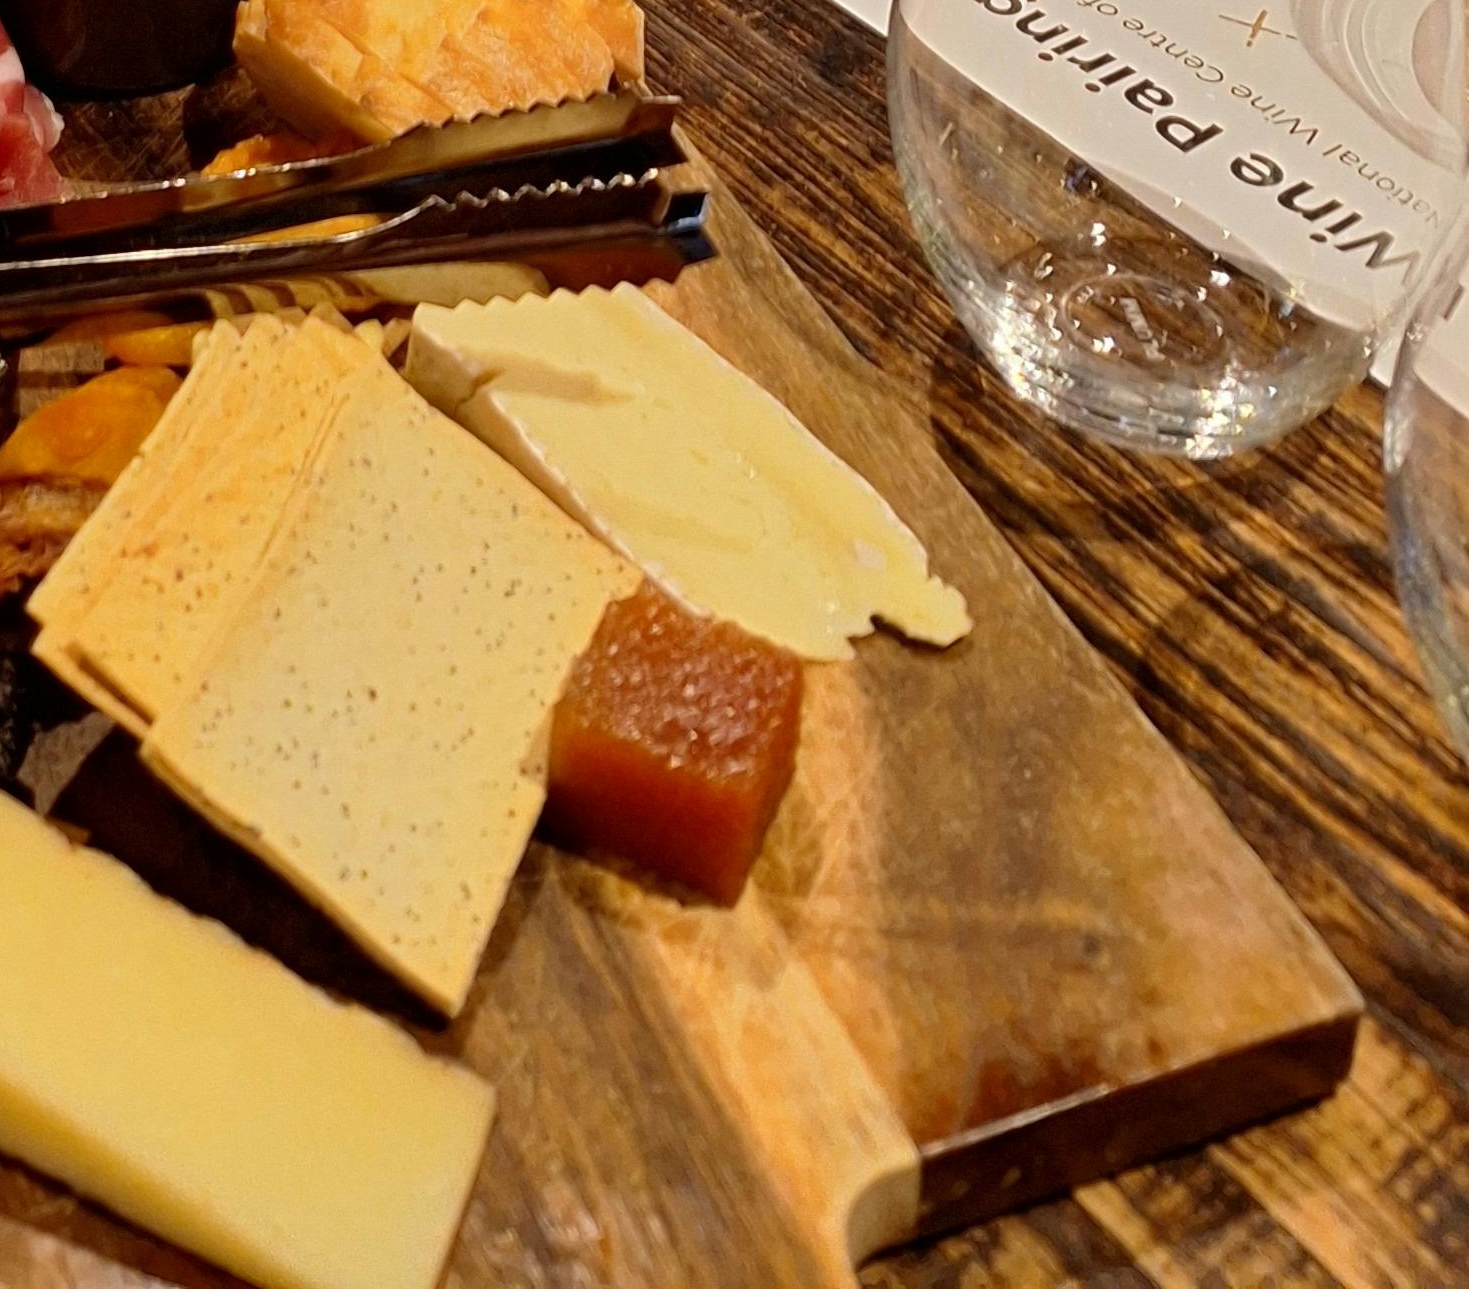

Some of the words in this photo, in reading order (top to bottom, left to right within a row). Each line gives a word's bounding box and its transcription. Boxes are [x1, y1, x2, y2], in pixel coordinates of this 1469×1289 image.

[1122, 18, 1224, 83] Centre
[1230, 84, 1320, 145] Wine
[1229, 152, 1421, 286] Wine
[1322, 144, 1440, 230] National
